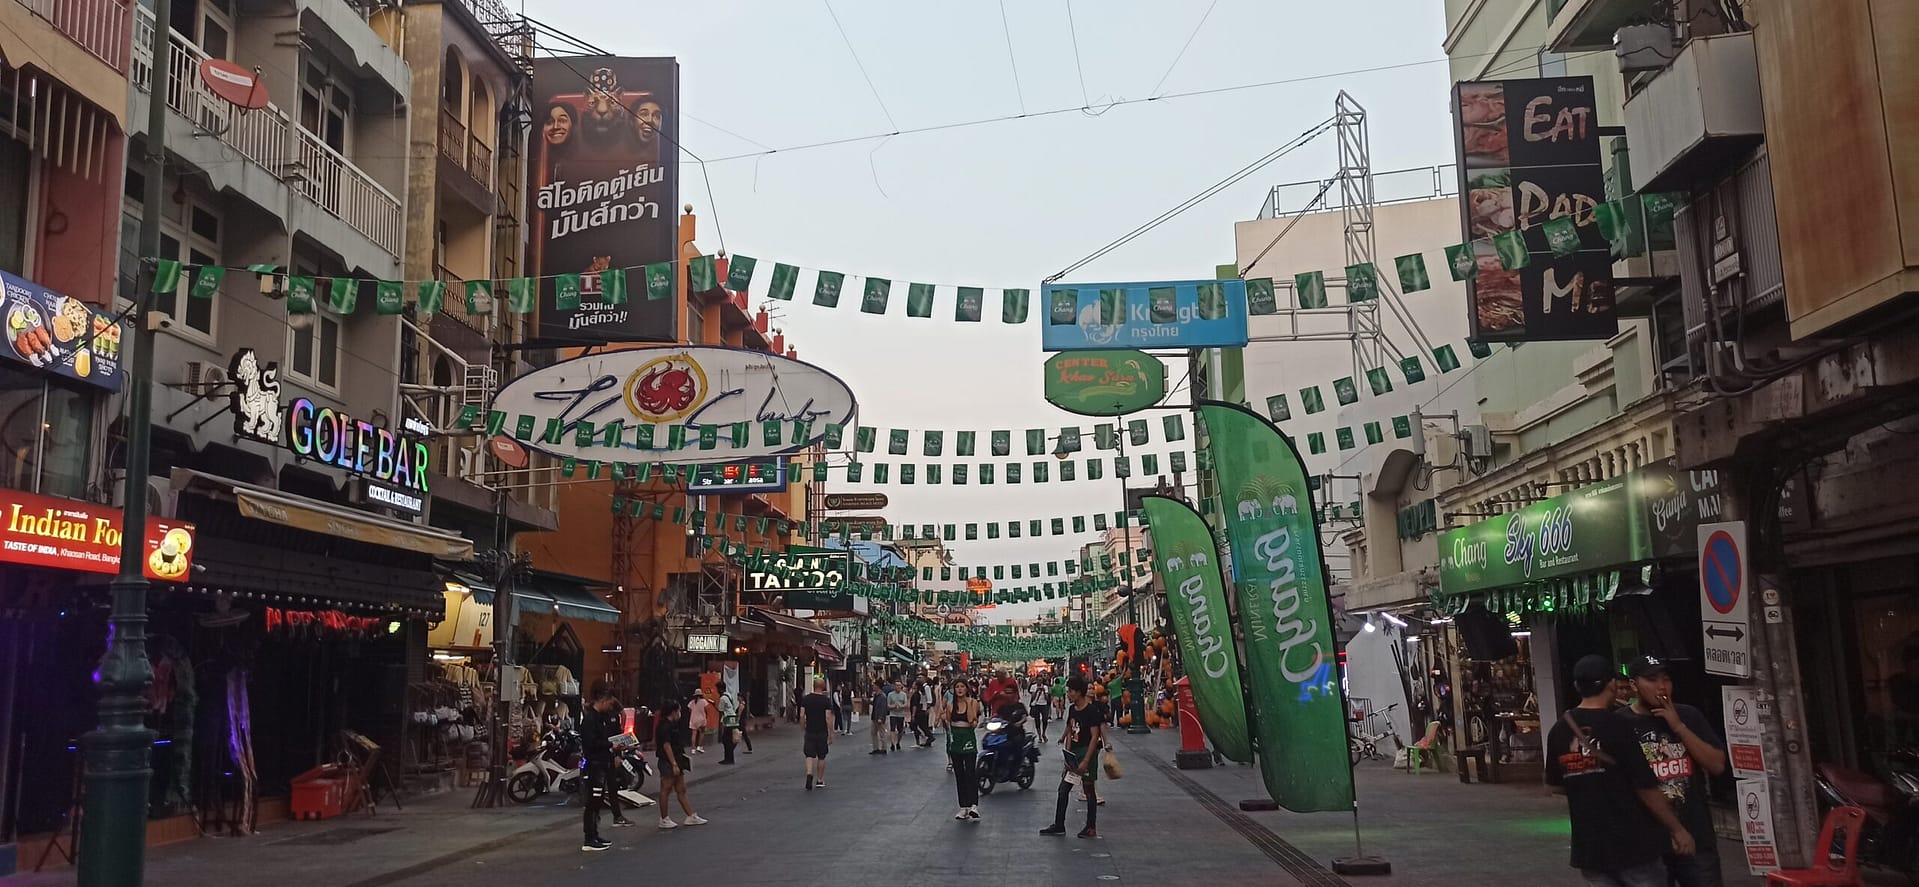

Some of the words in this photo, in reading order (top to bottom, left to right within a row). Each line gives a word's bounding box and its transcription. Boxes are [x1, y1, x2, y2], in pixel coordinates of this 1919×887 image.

[537, 164, 664, 209] ลีโอติดตู้เย็น
[551, 196, 659, 239] มันส์กว่า
[580, 274, 603, 293] LE
[1131, 302, 1229, 324] Krgti
[1131, 324, 1179, 341] กรุงไทย
[1056, 358, 1108, 369] CENTER
[291, 398, 374, 472] GOLF
[376, 429, 430, 492] BAR
[1653, 490, 1687, 532] Ganja
[7, 503, 86, 542] Indian
[4, 541, 27, 552] TASTE
[28, 543, 38, 553] OF
[1504, 513, 1535, 578] Sky
[1539, 504, 1573, 556] 666
[1453, 537, 1487, 569] Chang
[1556, 553, 1579, 565] Restaurant
[478, 612, 491, 628] 127
[1705, 648, 1746, 667] ตลอดเวลา
[1649, 758, 1688, 777] IGGIE
